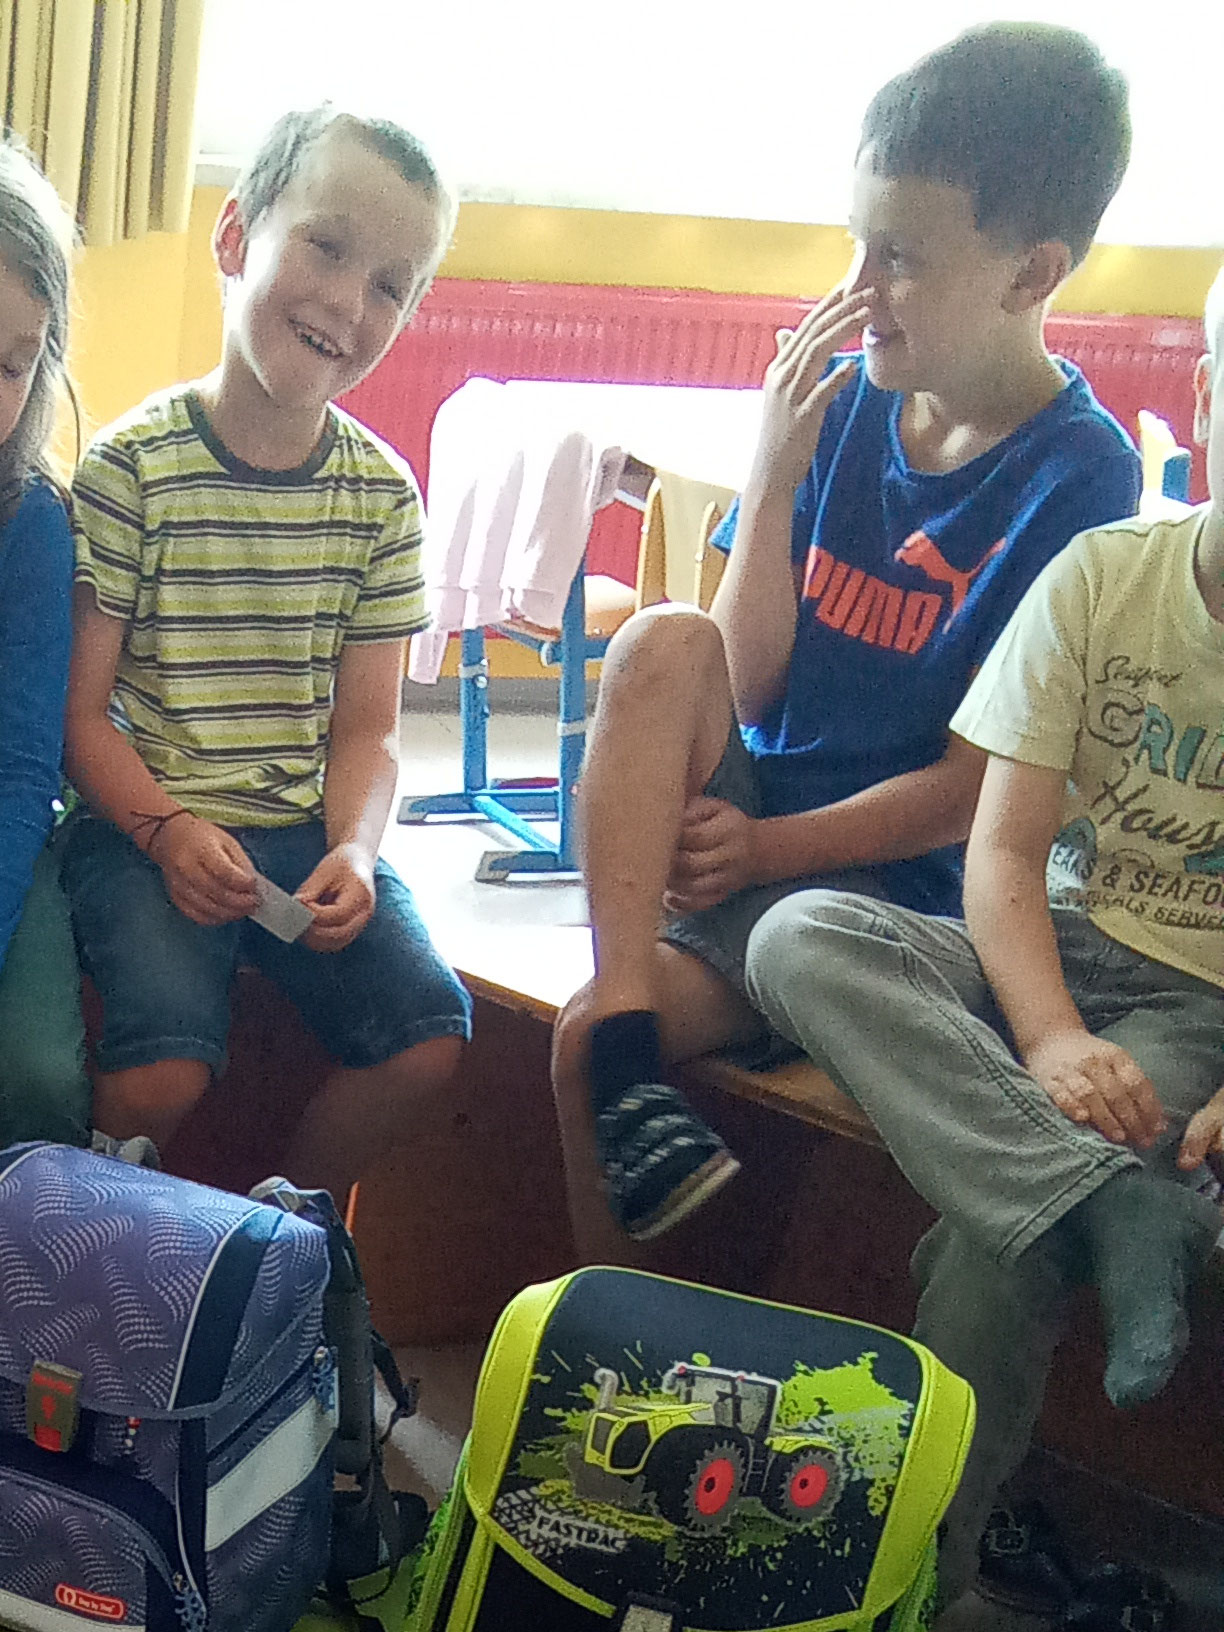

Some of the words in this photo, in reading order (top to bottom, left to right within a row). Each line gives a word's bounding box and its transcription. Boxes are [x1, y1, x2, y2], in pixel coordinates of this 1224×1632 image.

[803, 544, 943, 656] PUMA
[1102, 863, 1122, 890] &
[1129, 870, 1224, 908] SEAFO
[536, 1514, 626, 1550] FASTRAC
